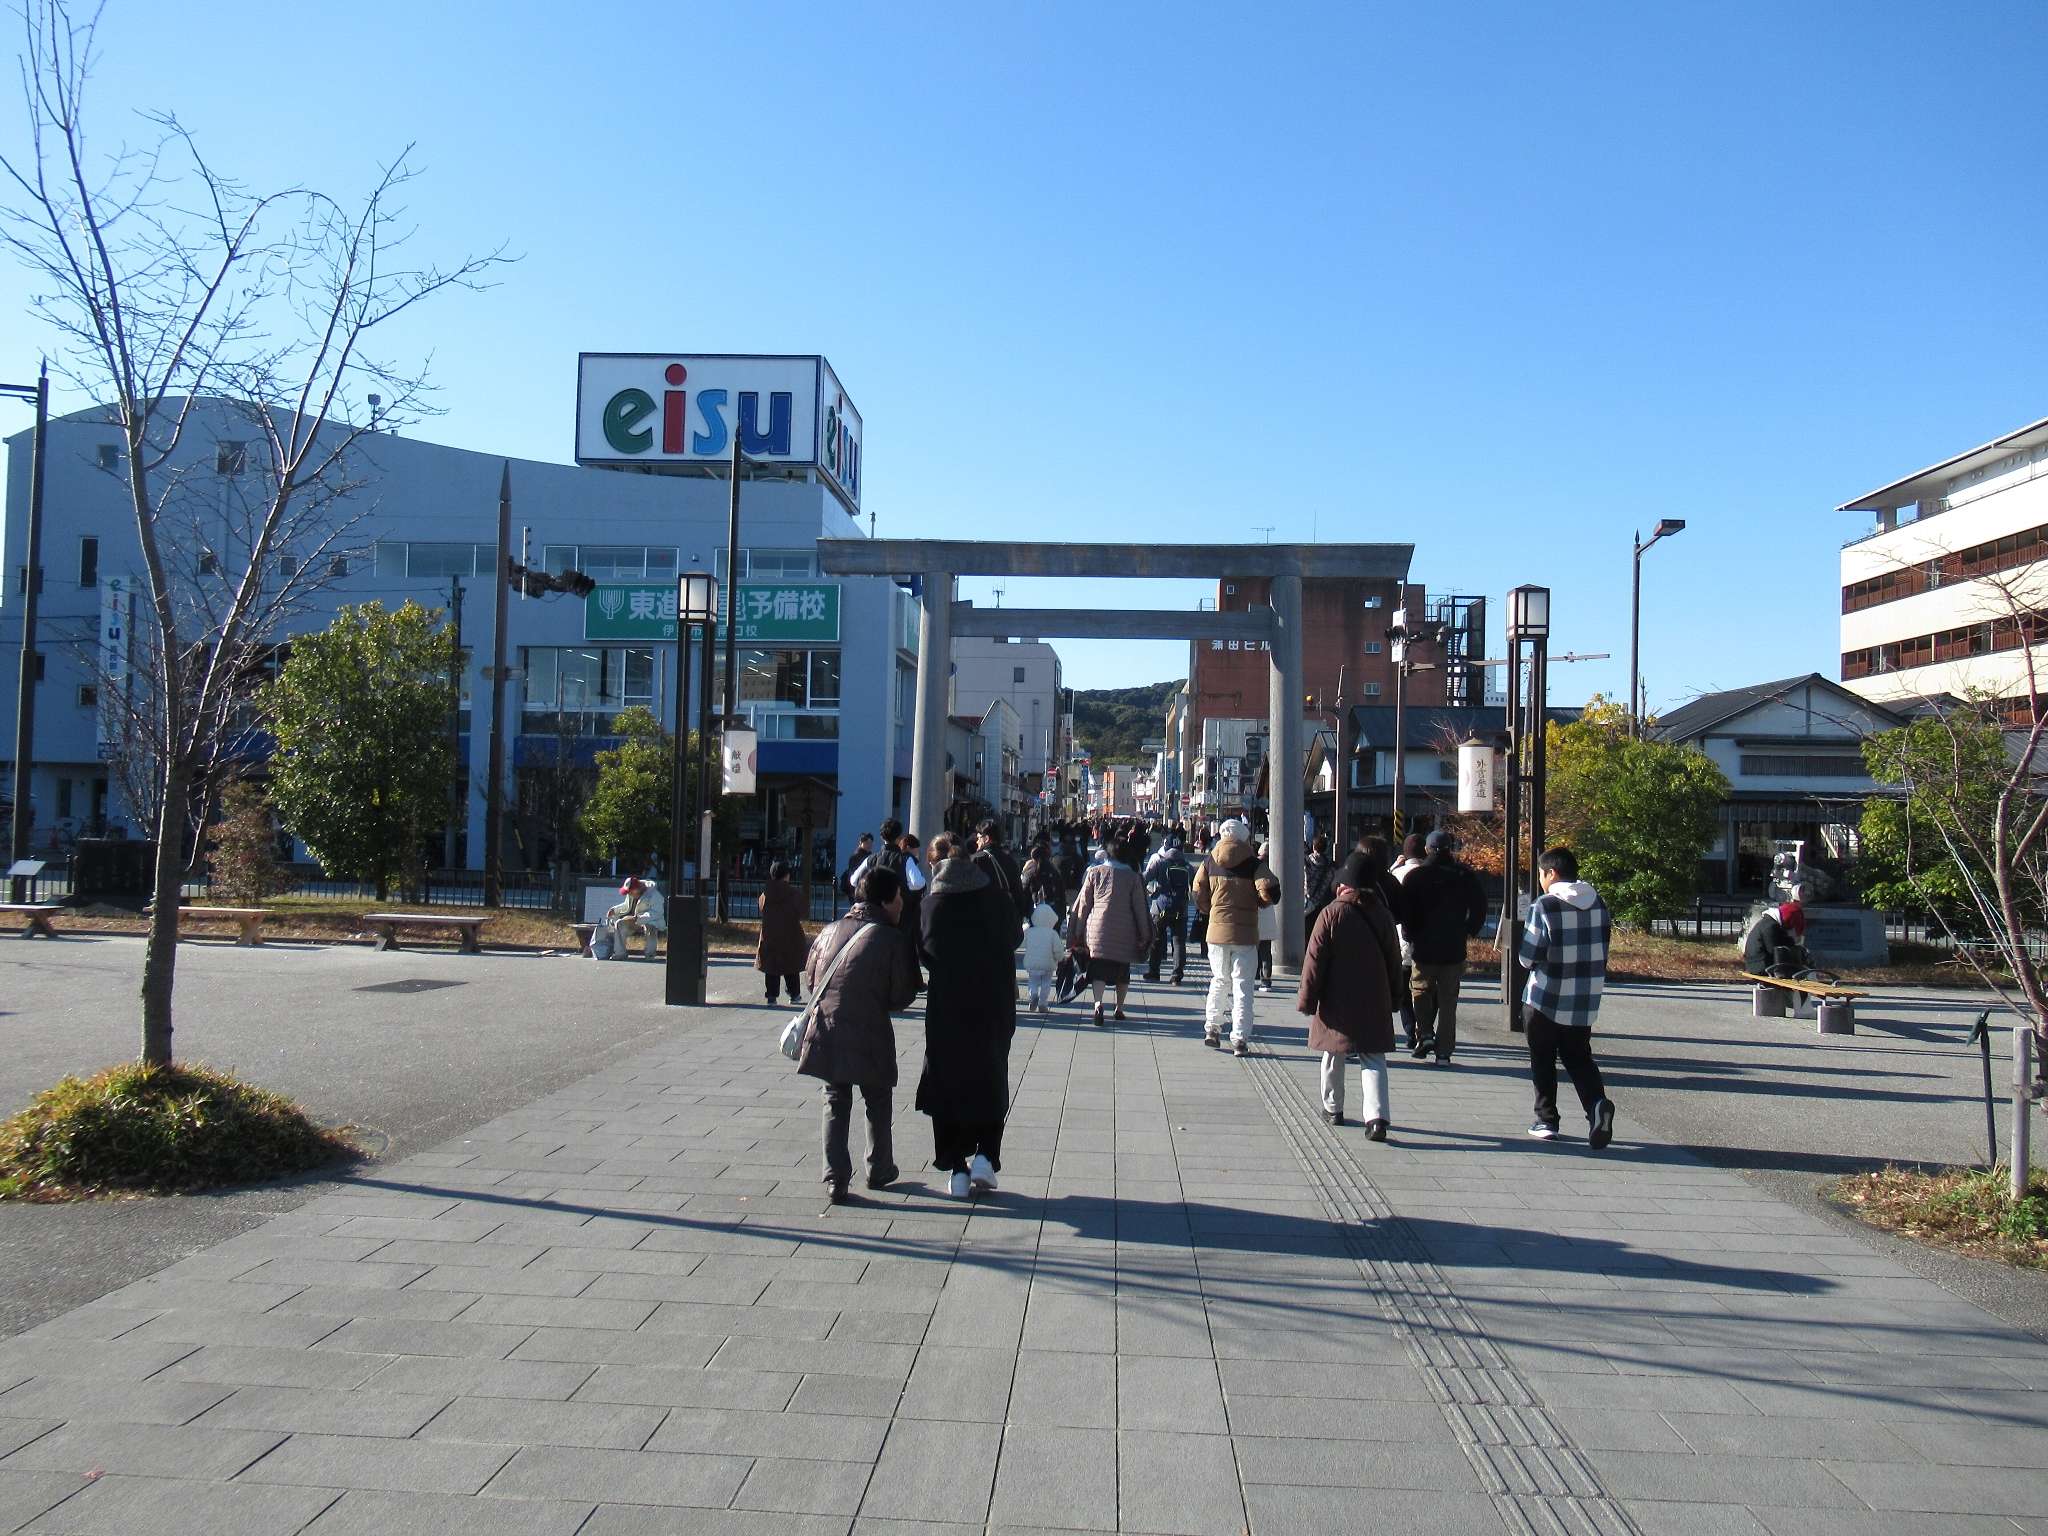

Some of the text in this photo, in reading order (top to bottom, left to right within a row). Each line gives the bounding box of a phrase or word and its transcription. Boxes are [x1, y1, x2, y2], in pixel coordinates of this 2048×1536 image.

[603, 363, 792, 454] eisu
[826, 393, 858, 499] eisu
[628, 590, 825, 621] 東進星予備校
